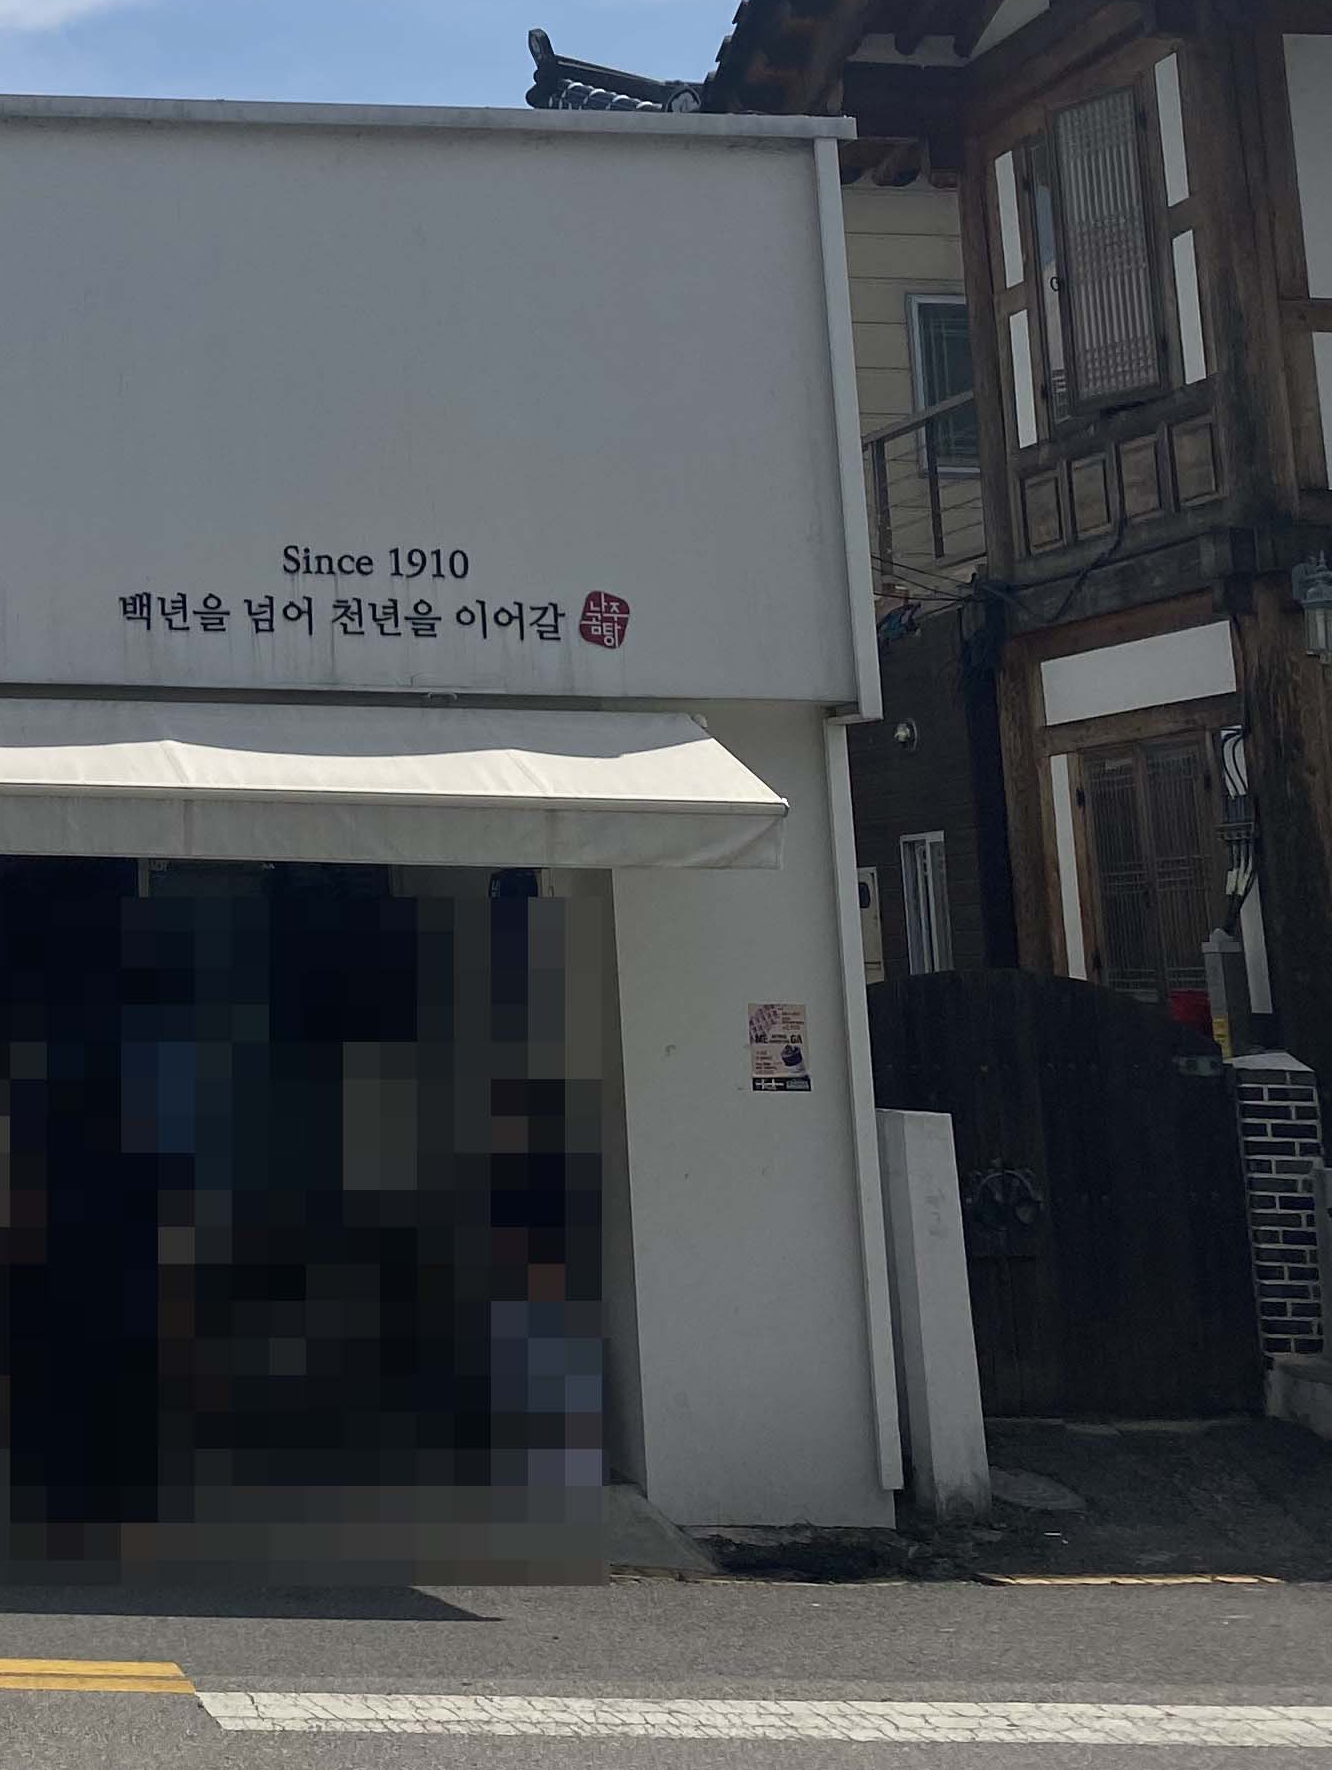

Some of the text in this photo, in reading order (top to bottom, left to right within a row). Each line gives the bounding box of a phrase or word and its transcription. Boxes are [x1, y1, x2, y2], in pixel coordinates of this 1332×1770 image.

[282, 545, 470, 579] Since 1910
[118, 591, 566, 642] 백년을 넘어 천년을 이어갈
